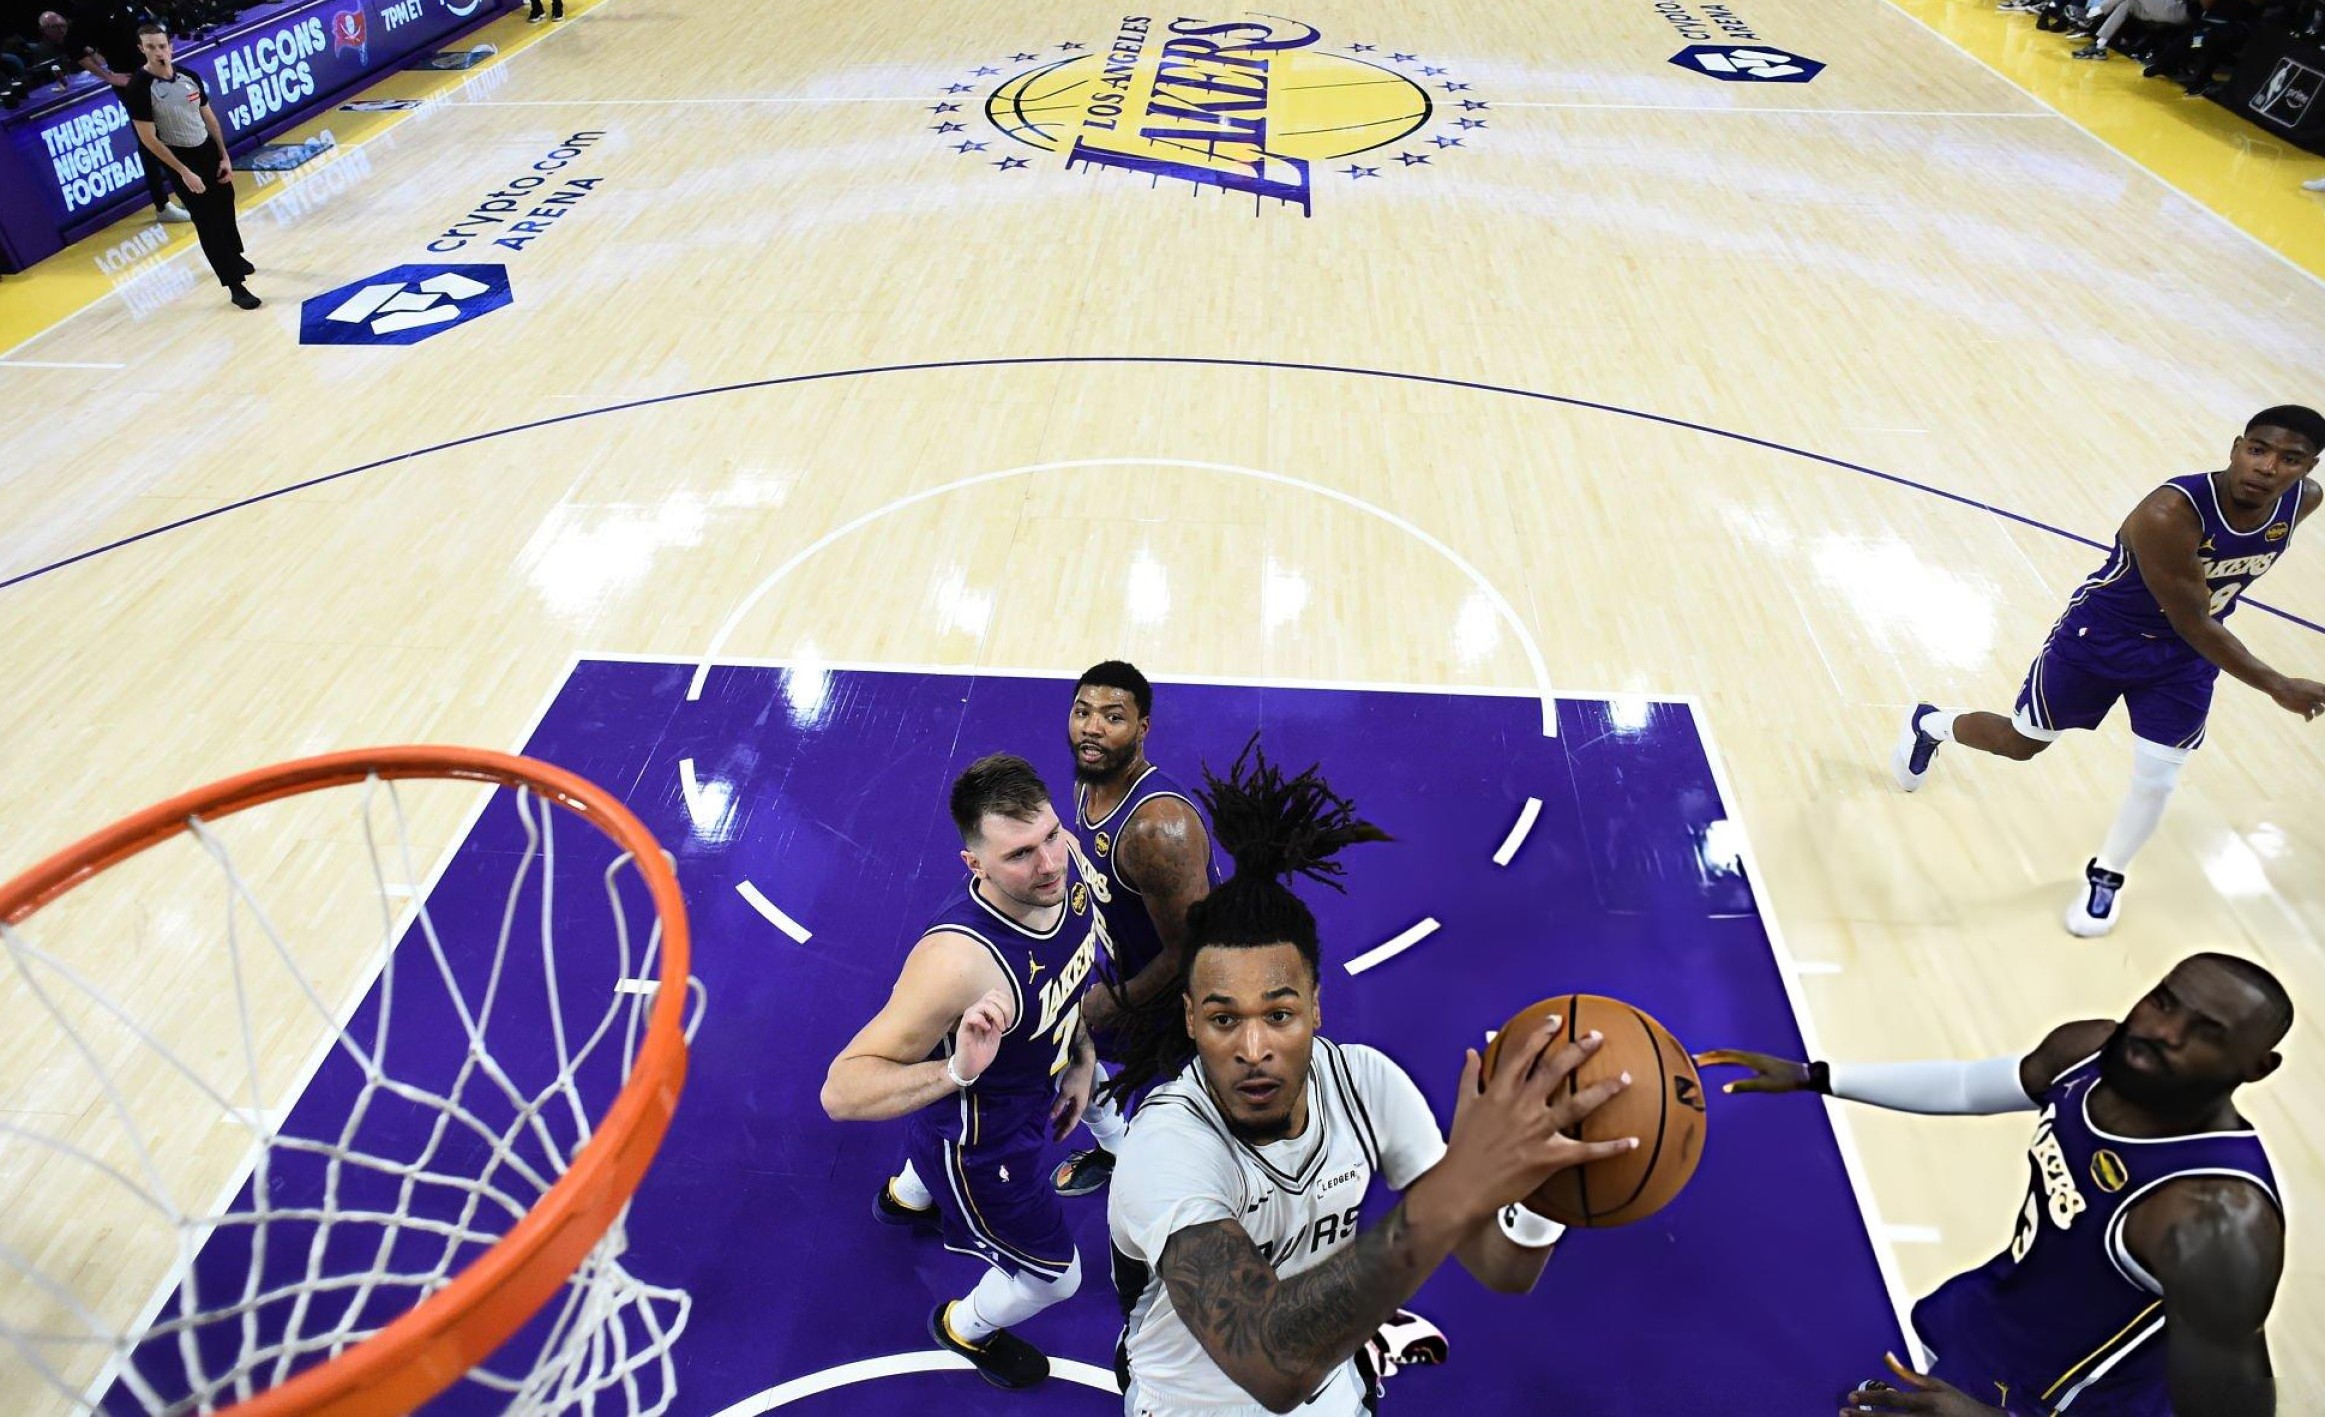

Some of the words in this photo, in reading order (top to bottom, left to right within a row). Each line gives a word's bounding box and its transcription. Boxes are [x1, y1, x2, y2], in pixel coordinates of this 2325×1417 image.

[1700, 4, 1761, 40] ARENA
[213, 16, 326, 95] FALCONS
[1100, 15, 1152, 91] ANGELES
[246, 61, 314, 120] BUCS
[1065, 11, 1321, 218] LAKERS
[1083, 92, 1125, 131] LOS
[41, 100, 130, 157] THURSDA
[52, 135, 115, 185] NIGHT
[426, 131, 607, 253] crypto.com
[492, 177, 604, 251] ARENA
[1321, 1170, 1356, 1192] LEDGER
